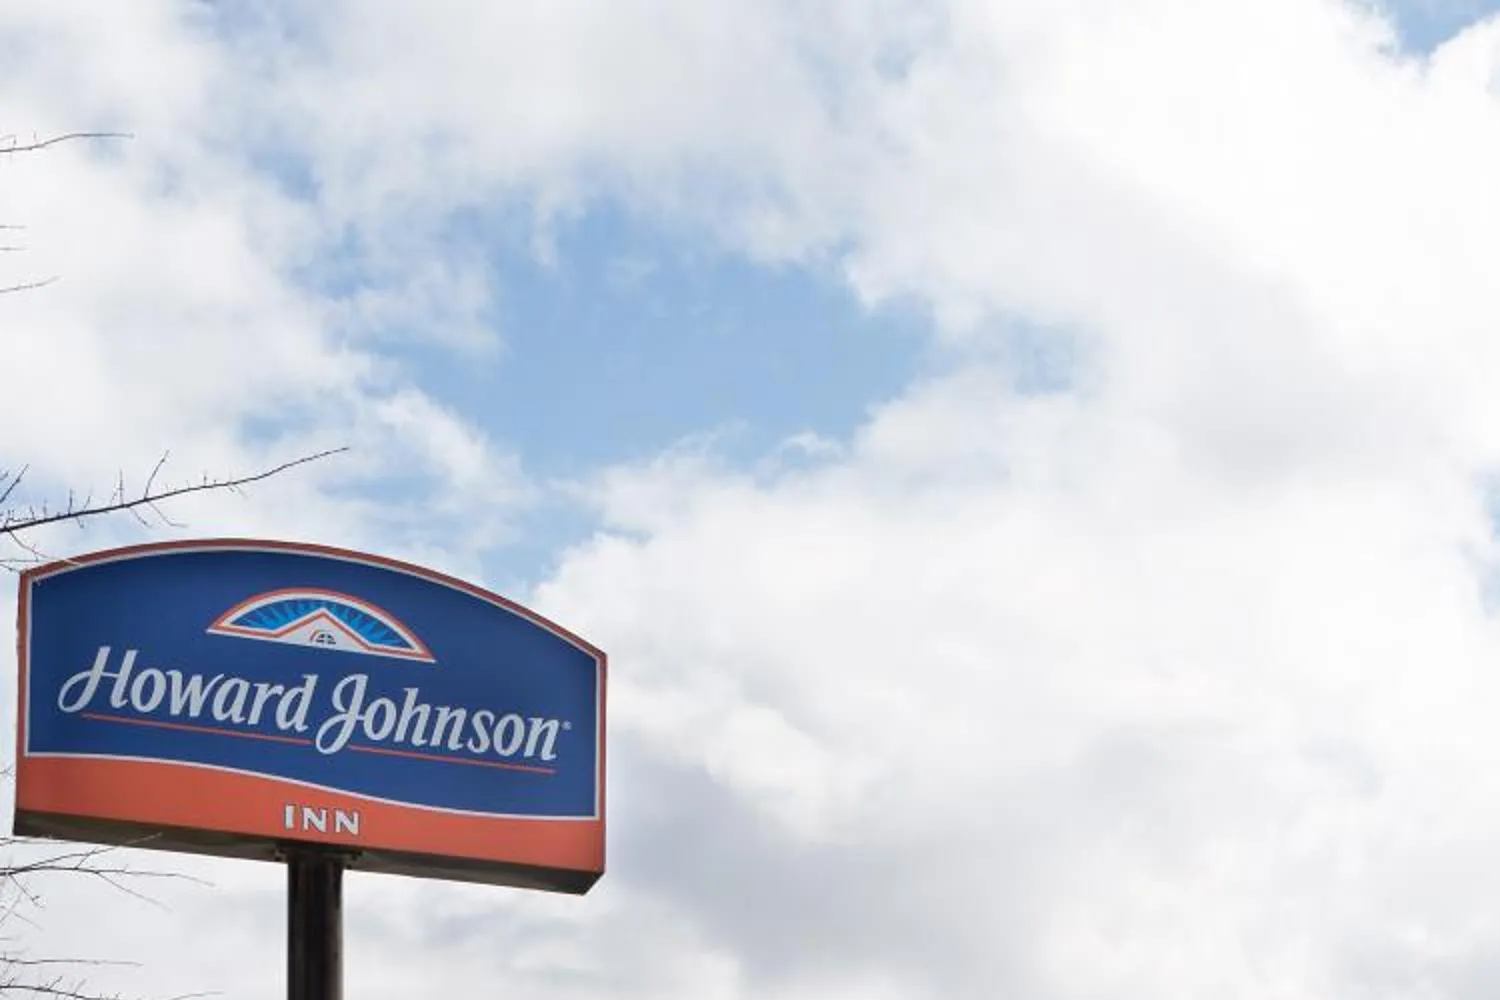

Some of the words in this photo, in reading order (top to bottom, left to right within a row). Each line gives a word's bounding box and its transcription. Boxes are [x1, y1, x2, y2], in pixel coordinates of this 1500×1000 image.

[58, 646, 316, 733] Howard
[314, 673, 559, 761] Johnson
[284, 804, 361, 836] INN
